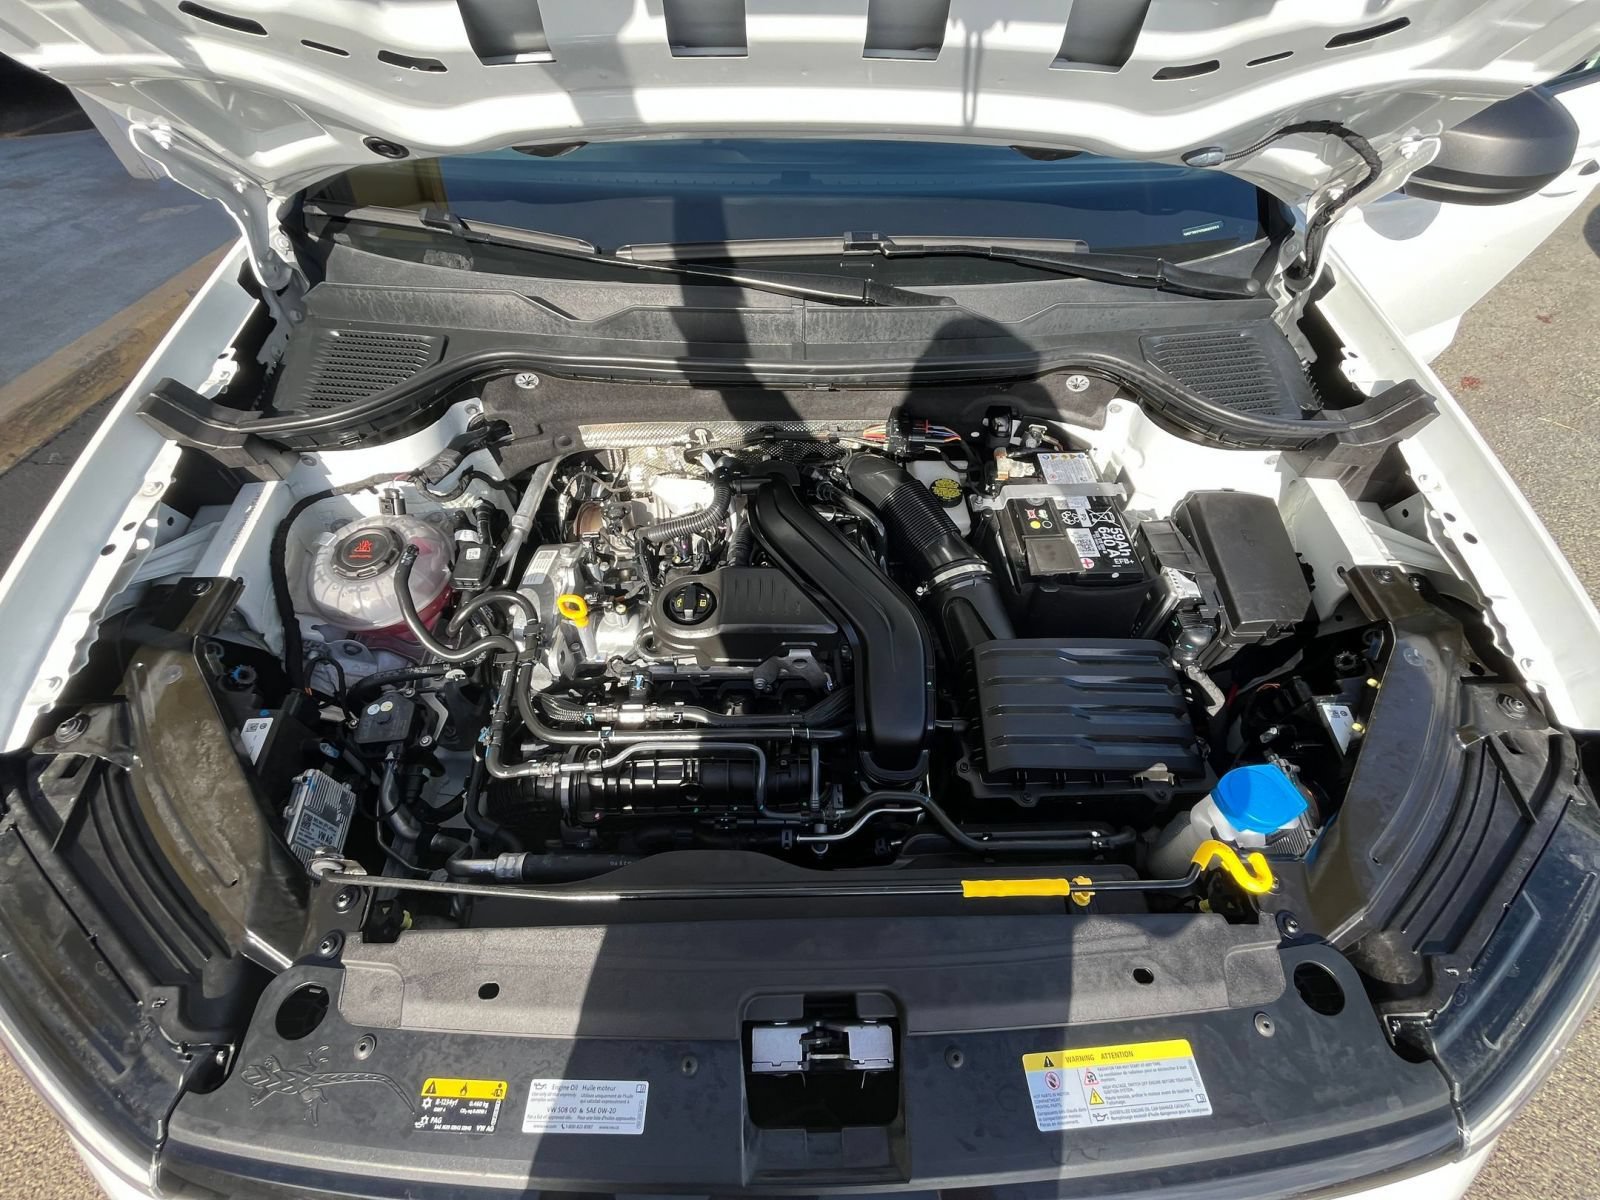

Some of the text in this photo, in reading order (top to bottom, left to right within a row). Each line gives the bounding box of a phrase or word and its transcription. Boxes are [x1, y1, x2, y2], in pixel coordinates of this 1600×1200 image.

[1098, 526, 1116, 547] 640
[1110, 527, 1132, 557] 59Ah
[1106, 548, 1121, 558] A
[1065, 1050, 1134, 1064] WARNING ATTENTION
[551, 1083, 570, 1092] Engine
[557, 1106, 569, 1114] 508
[569, 1106, 578, 1114] 00
[429, 1116, 443, 1124] PAG
